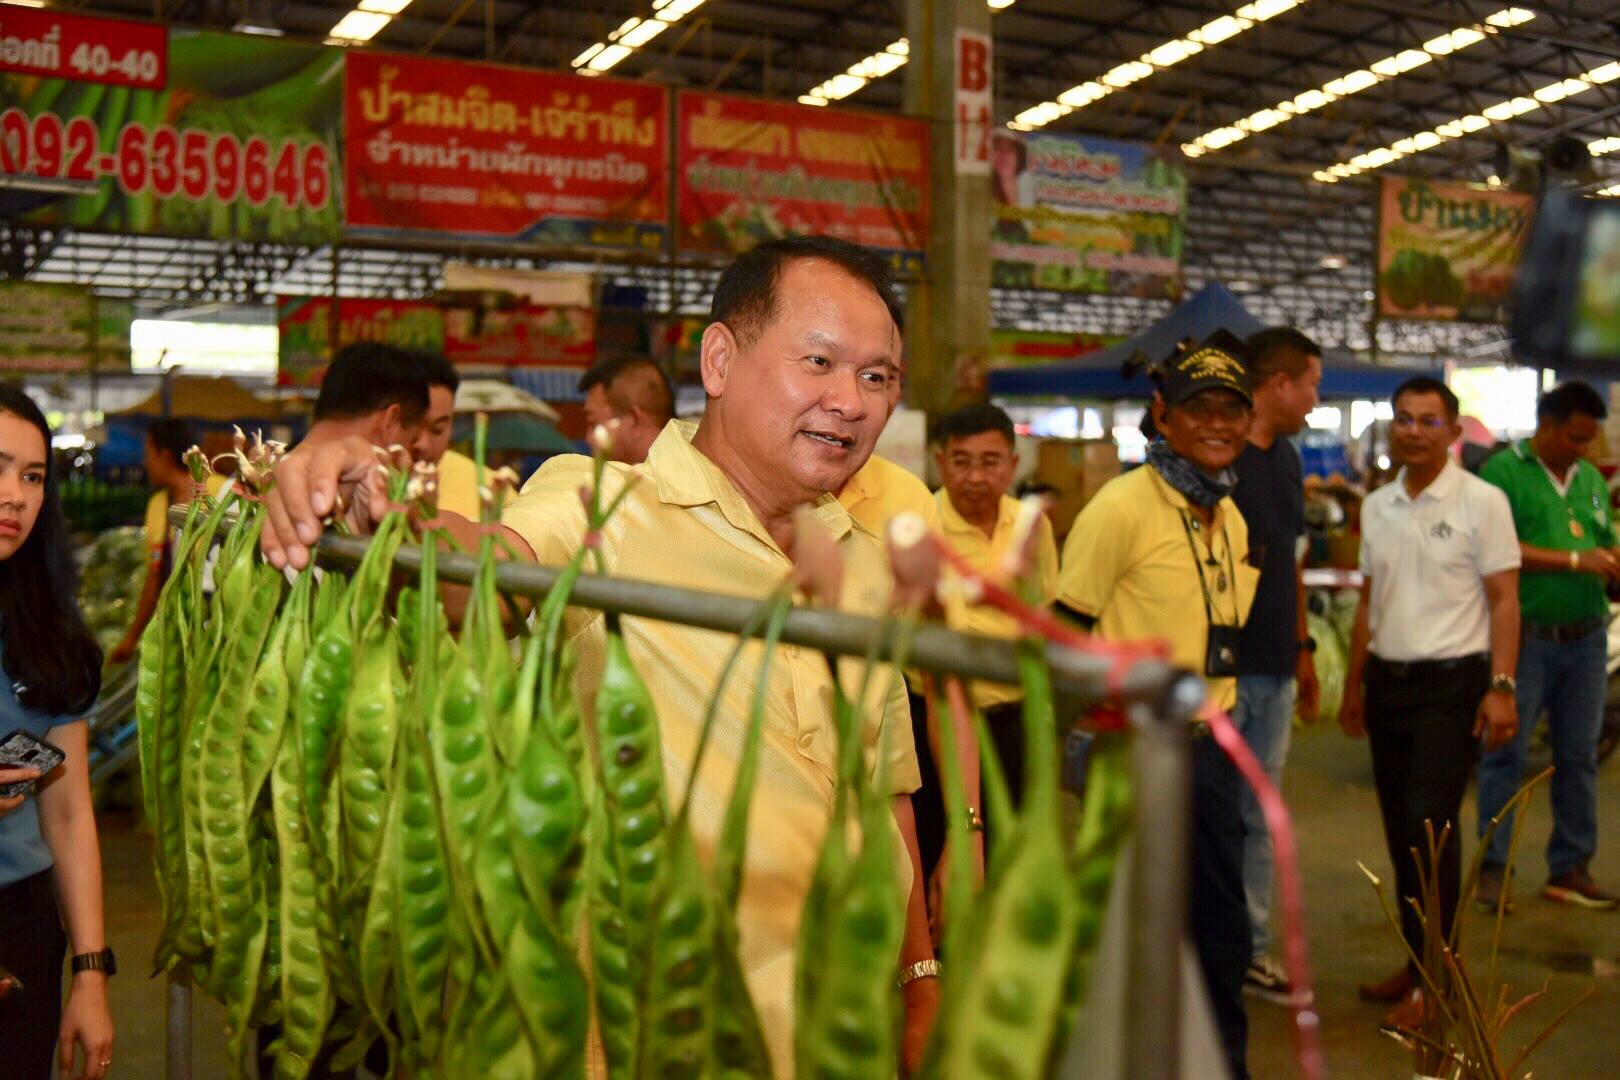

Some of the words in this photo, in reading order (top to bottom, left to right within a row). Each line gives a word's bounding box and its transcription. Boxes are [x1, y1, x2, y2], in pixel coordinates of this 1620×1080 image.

[70, 42, 159, 81] 40-40
[960, 37, 988, 92] B
[1, 108, 329, 209] 092-6359646
